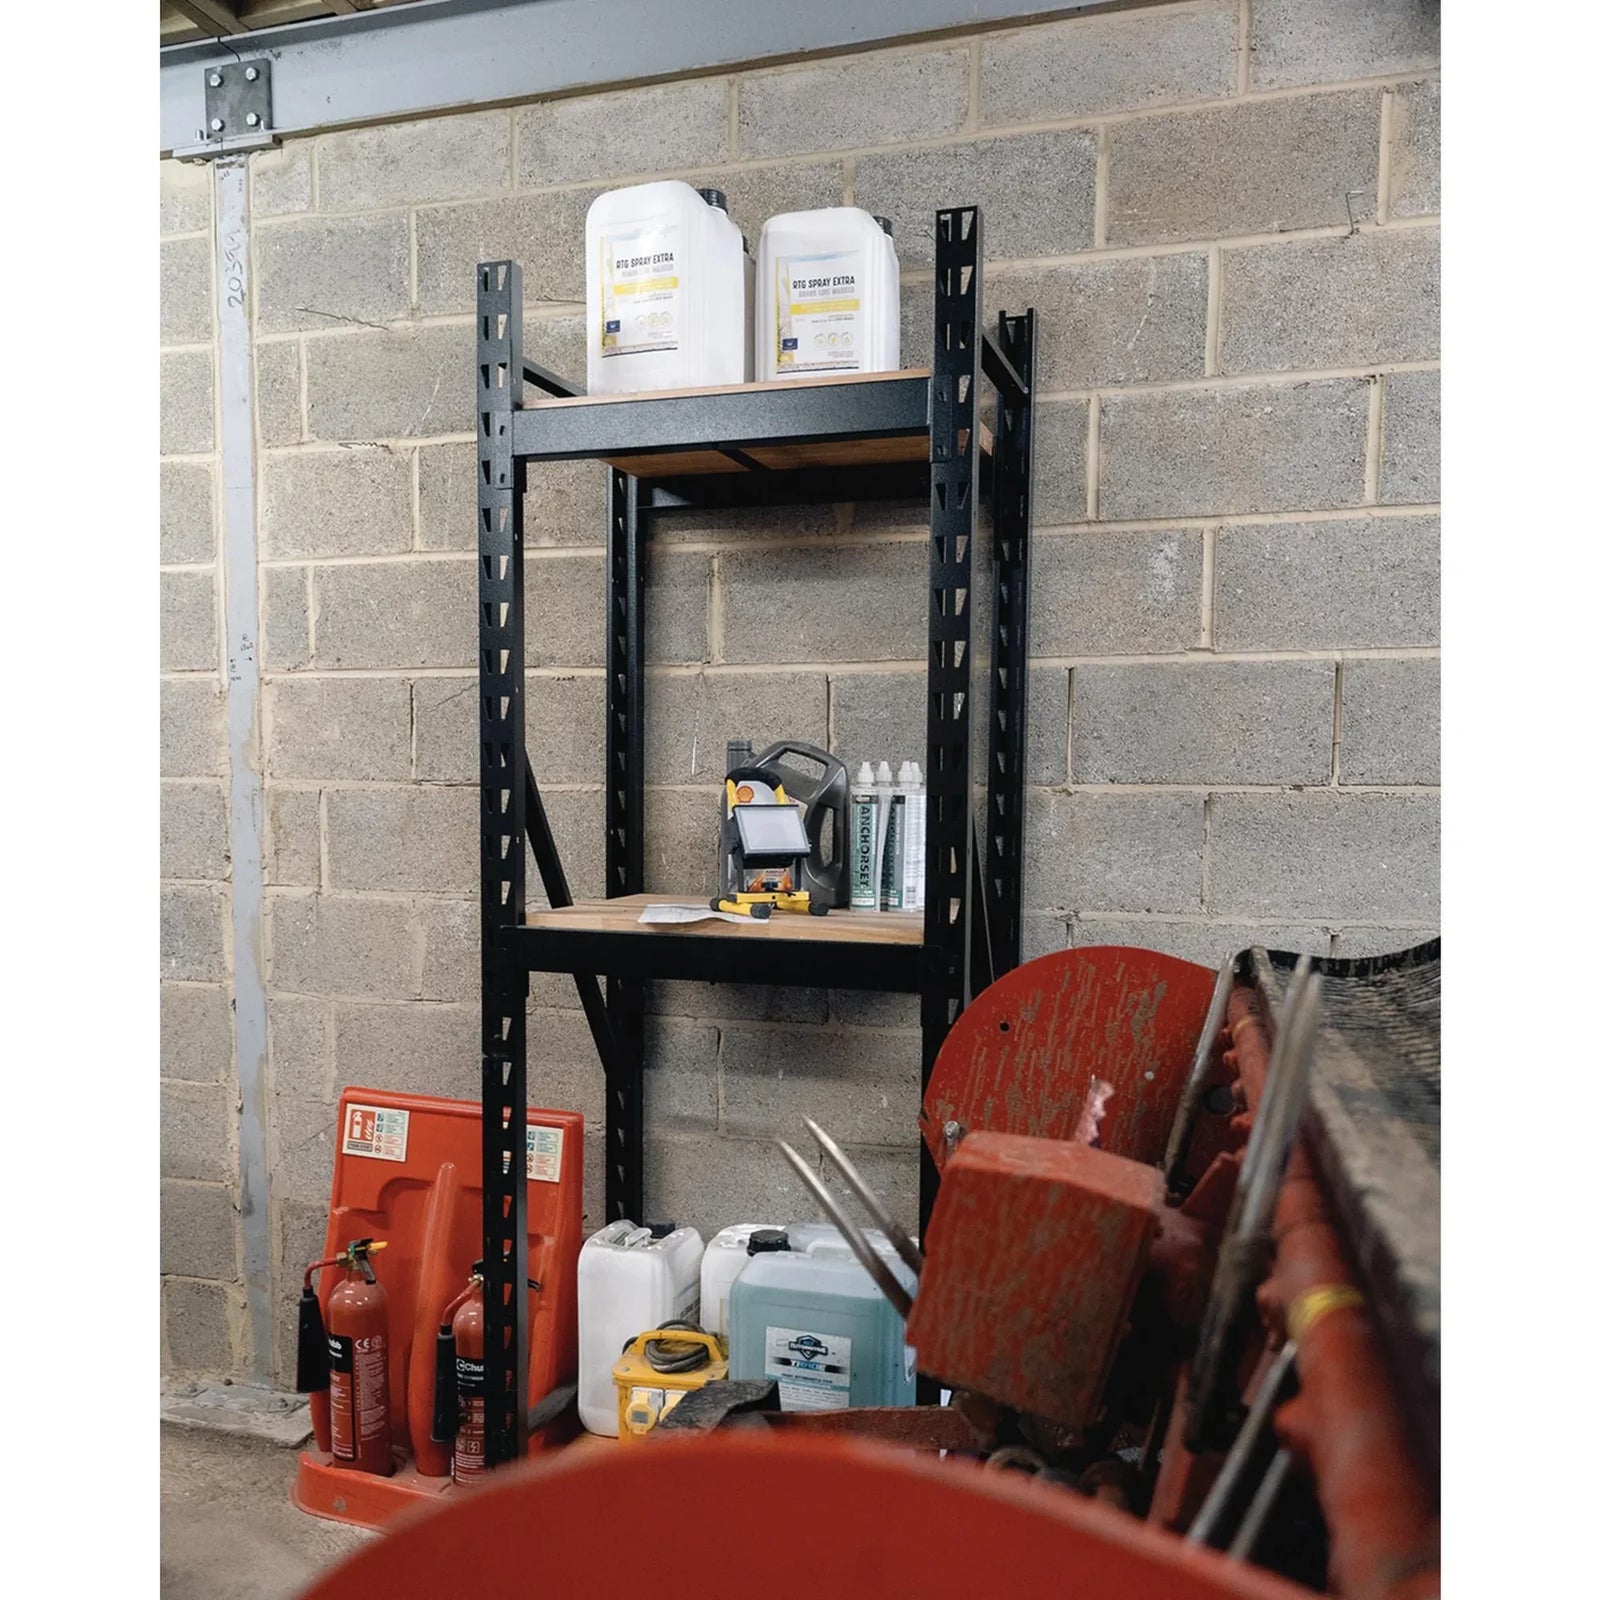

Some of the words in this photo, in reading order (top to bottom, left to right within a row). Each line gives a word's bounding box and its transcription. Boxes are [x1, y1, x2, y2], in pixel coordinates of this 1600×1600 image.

[616, 259, 630, 270] RTG
[631, 255, 652, 268] SPRAY
[653, 252, 675, 264] EXTRA
[792, 280, 807, 289] RTG
[808, 277, 832, 289] SPRAY
[832, 275, 856, 286] EXTRA
[355, 1338, 370, 1350] CE
